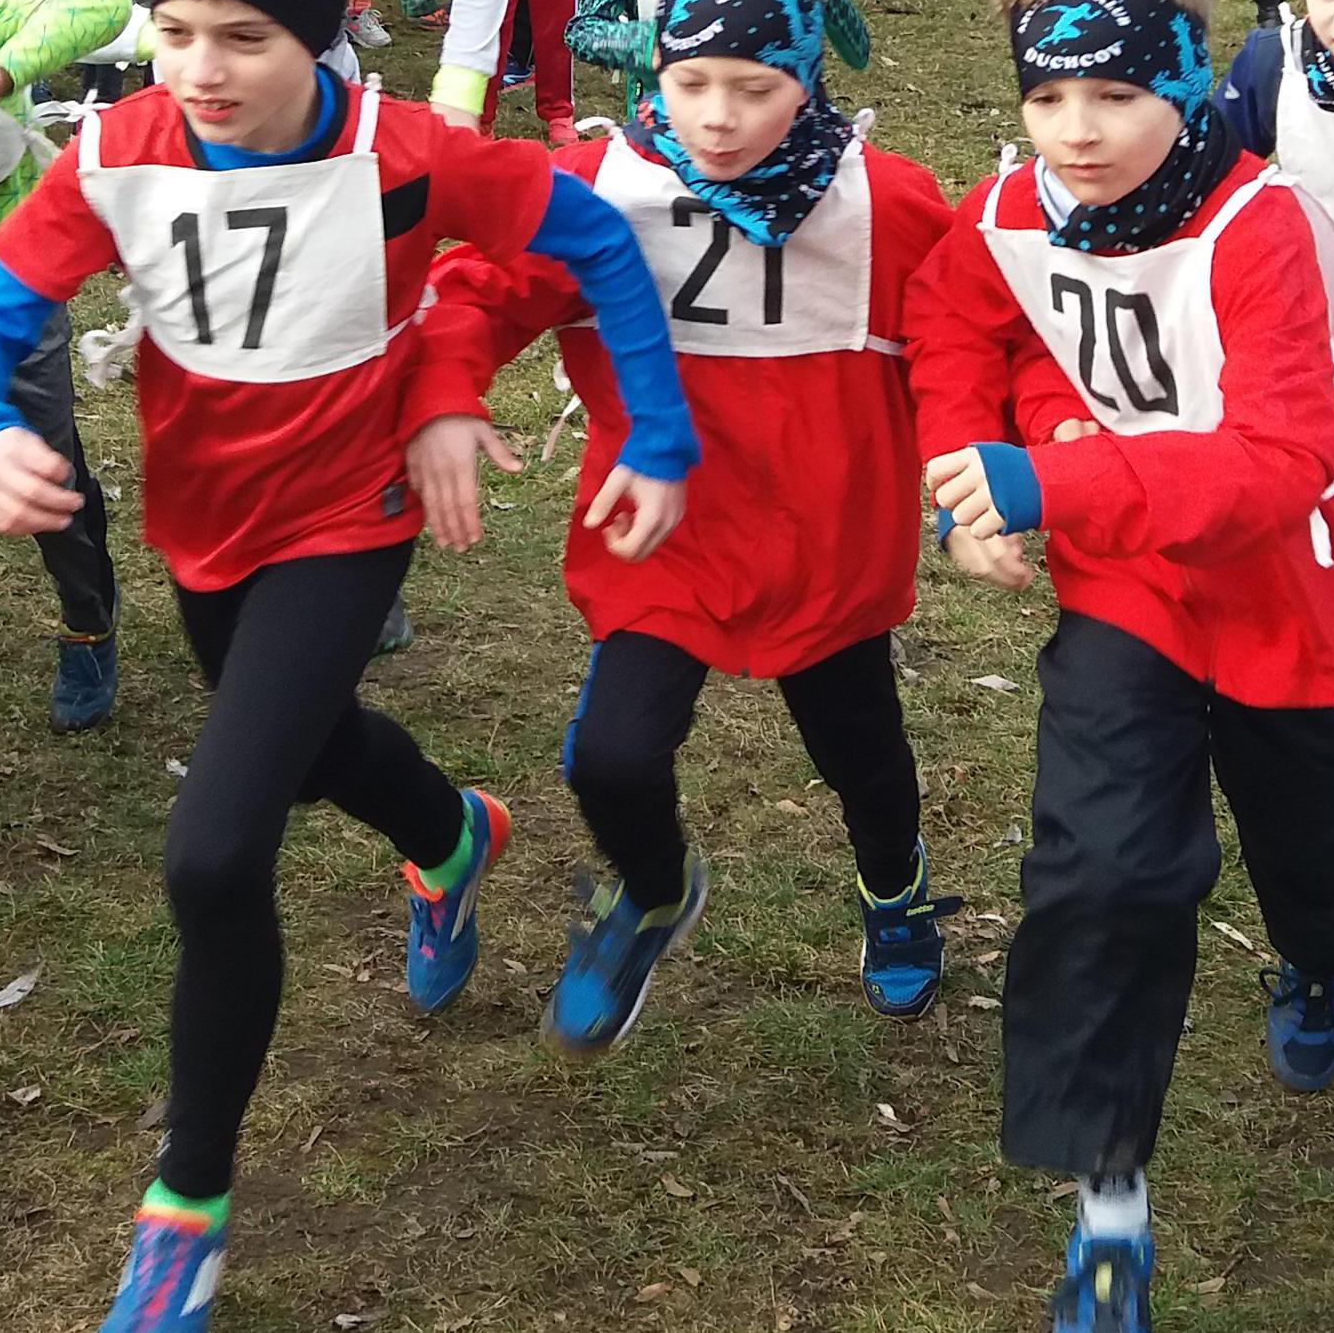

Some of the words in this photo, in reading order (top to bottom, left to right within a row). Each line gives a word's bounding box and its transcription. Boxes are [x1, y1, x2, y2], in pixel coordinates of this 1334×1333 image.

[1023, 42, 1124, 70] DUCHCOV
[170, 206, 287, 349] 17
[672, 196, 784, 325] 21
[1051, 273, 1179, 417] 20
